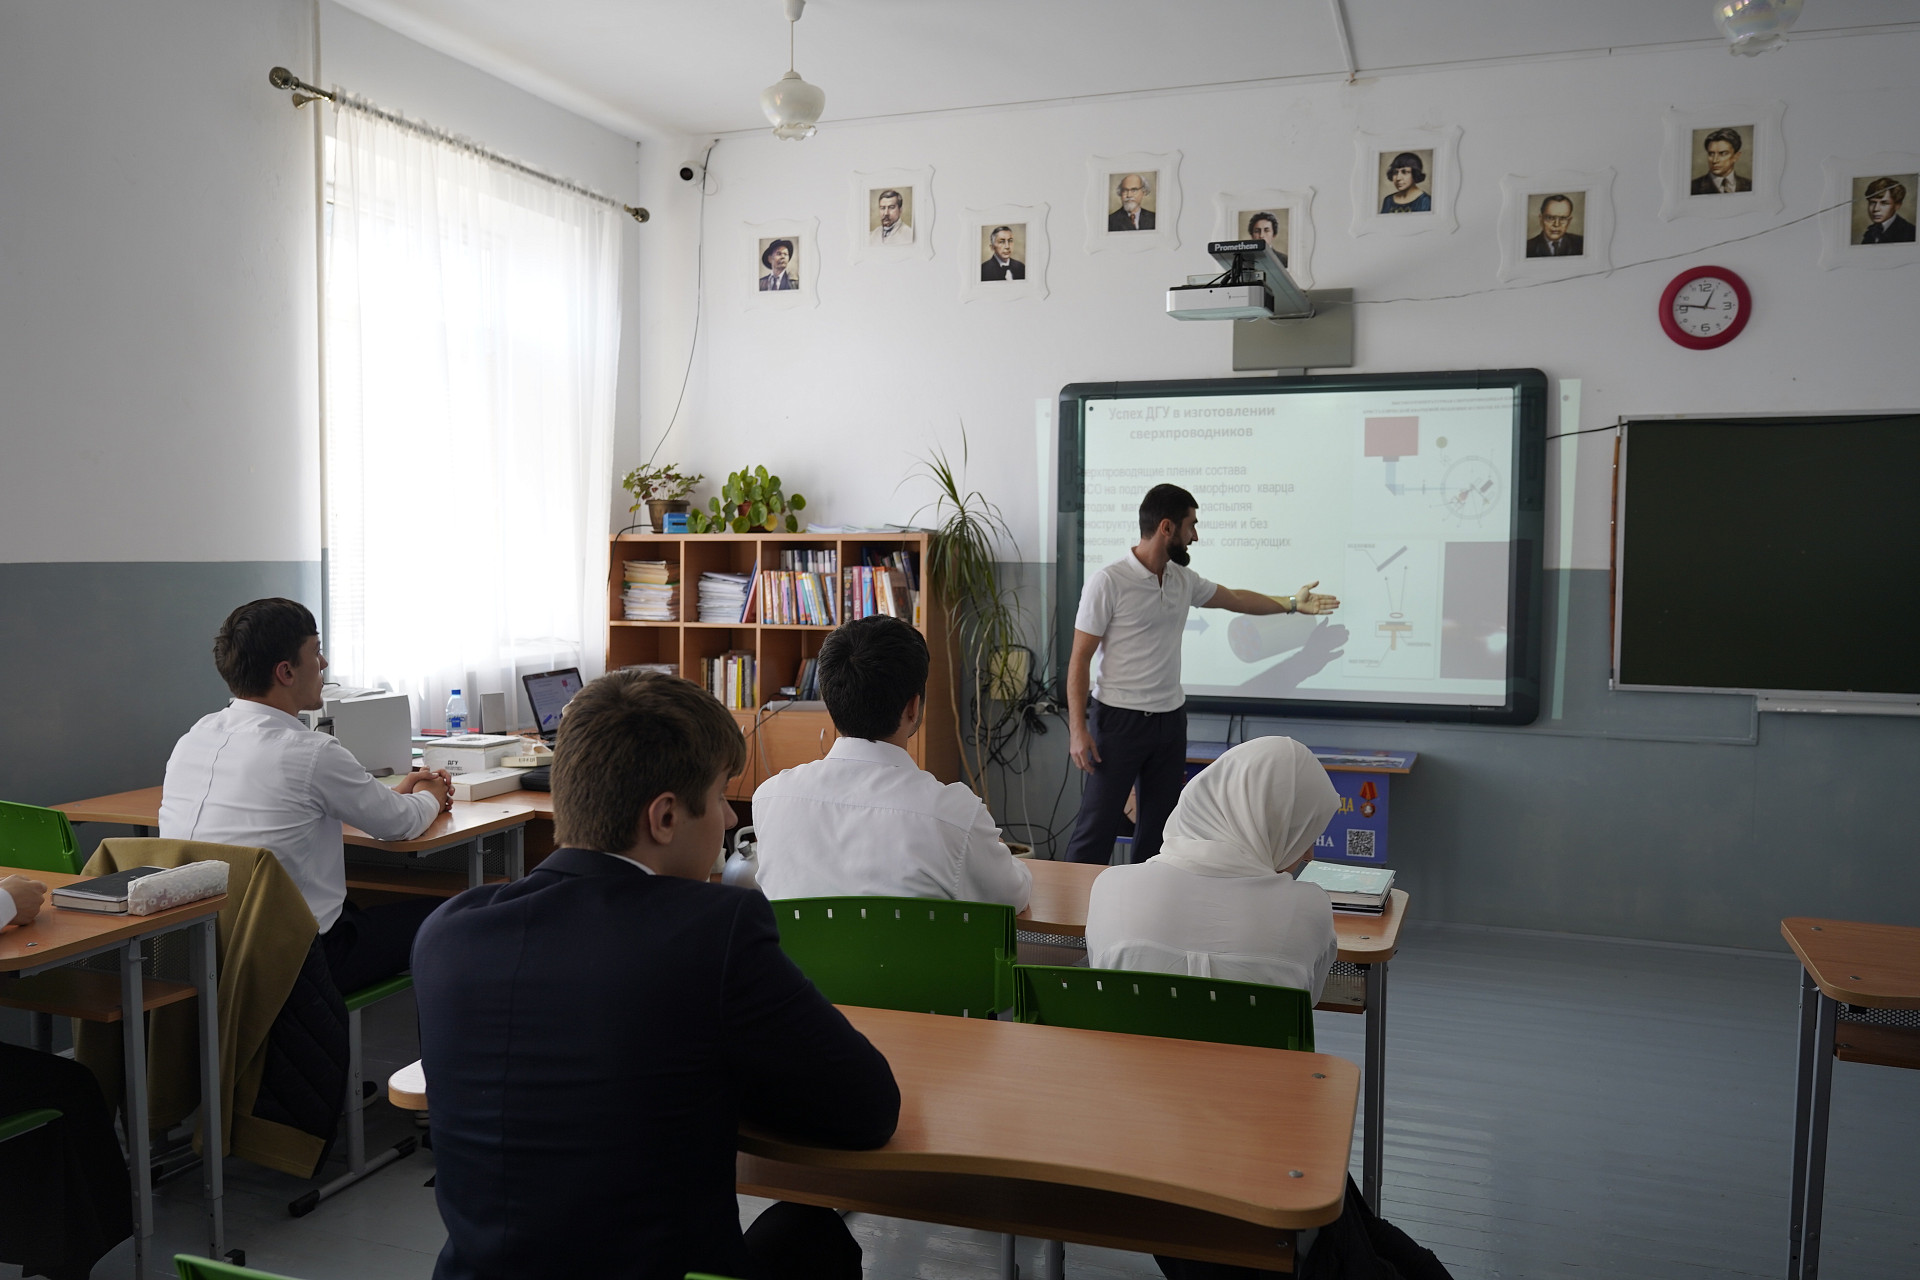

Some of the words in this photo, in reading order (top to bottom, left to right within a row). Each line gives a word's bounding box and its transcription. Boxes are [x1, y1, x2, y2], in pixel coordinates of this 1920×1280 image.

[1214, 242, 1258, 252] Promethean
[1698, 283, 1712, 292] 12
[1679, 305, 1688, 314] 9
[1723, 302, 1732, 310] 3
[1701, 323, 1710, 332] 6
[1108, 407, 1143, 421] Успех
[1145, 406, 1171, 421] ДГУ
[1173, 408, 1181, 418] в
[1183, 405, 1275, 418] изготовлении
[1129, 427, 1253, 441] сверхпроводников
[1166, 466, 1202, 477] пленки
[1205, 465, 1247, 477] состава
[1104, 486, 1116, 496] на
[1118, 486, 1149, 498] подло
[1193, 483, 1251, 497] аморфного
[1256, 482, 1295, 496] кварца
[1240, 520, 1247, 529] и
[1249, 516, 1269, 529] без
[1220, 535, 1292, 550] согласующих
[1338, 797, 1354, 814] ДА
[1315, 835, 1334, 847] НА
